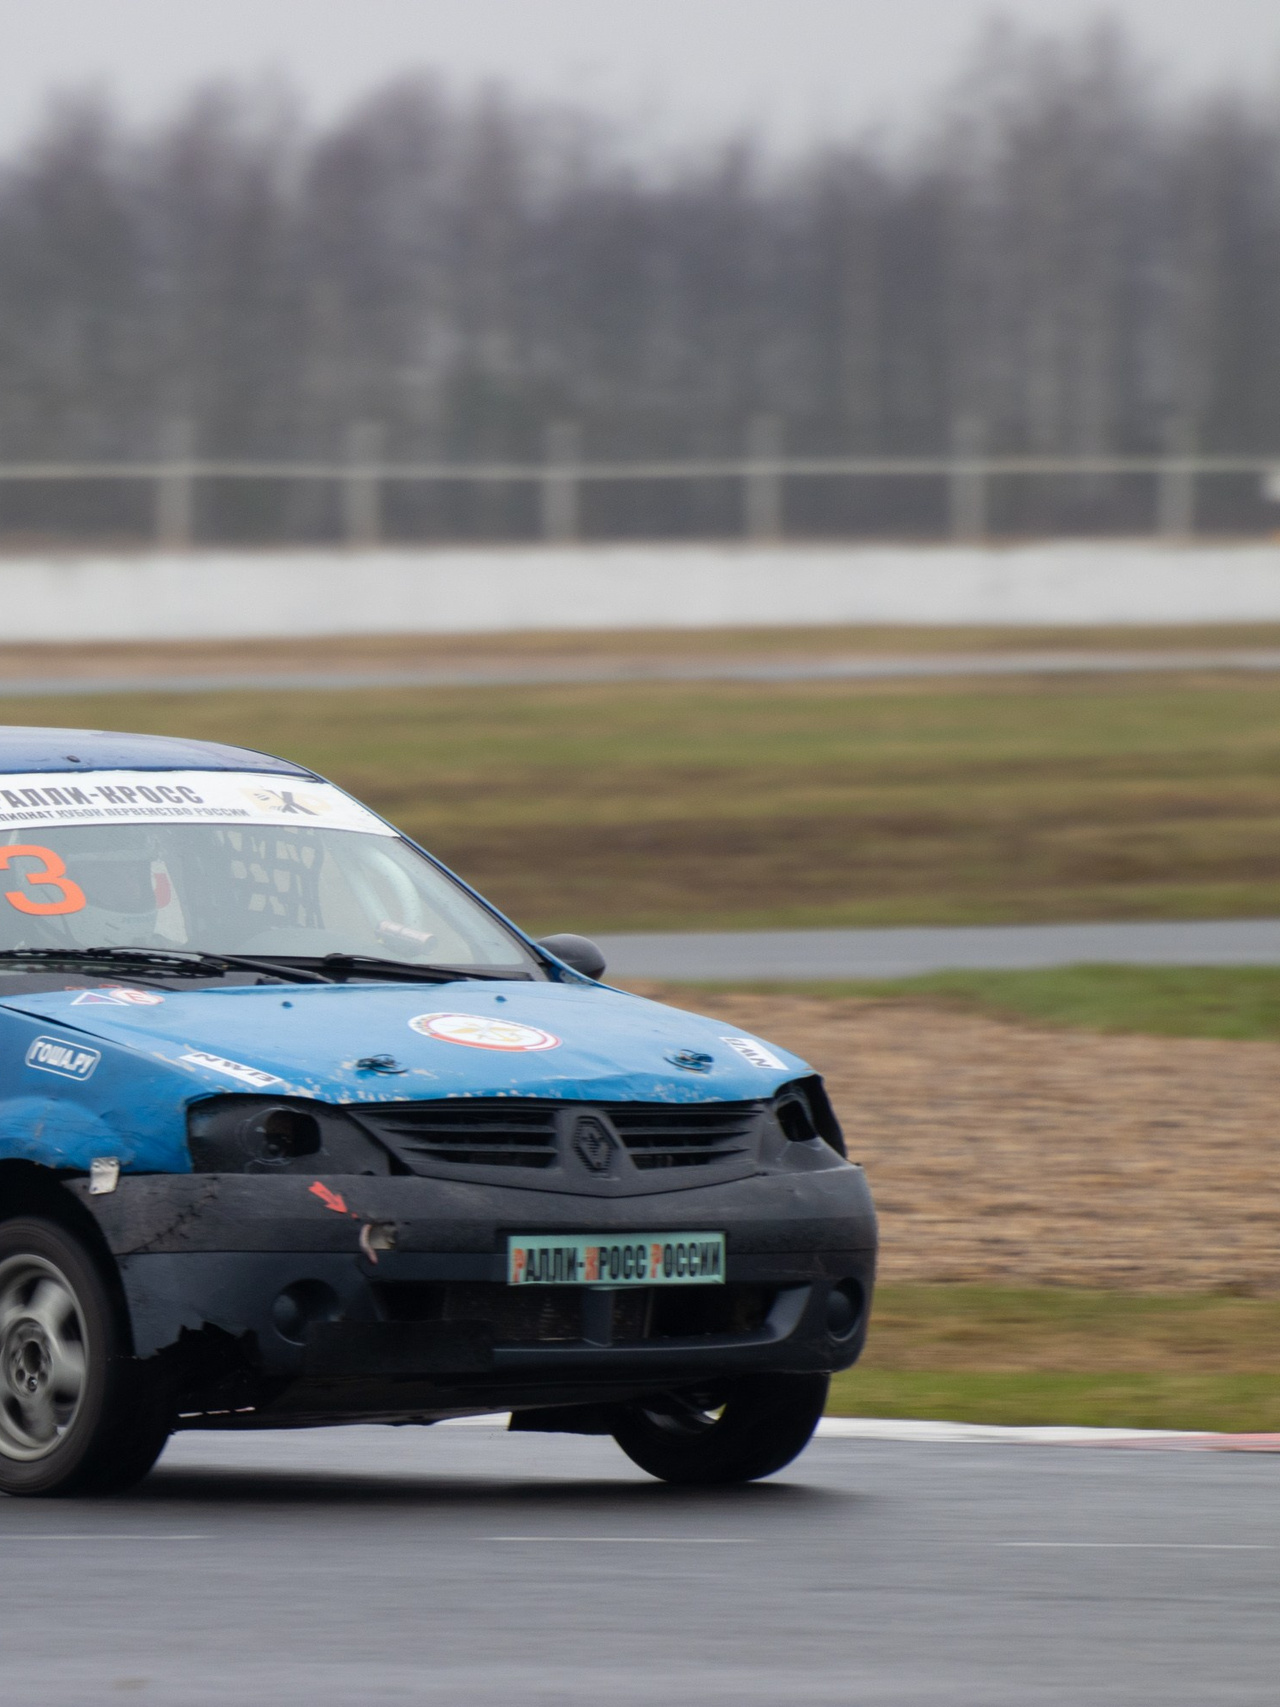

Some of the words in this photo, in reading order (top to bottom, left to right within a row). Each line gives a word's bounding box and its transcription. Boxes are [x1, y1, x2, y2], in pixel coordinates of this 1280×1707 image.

[55, 808, 102, 819] КУБОК
[104, 807, 195, 818] ПЕРВЕНСТВО
[195, 807, 251, 817] РОССИИ
[29, 1041, 96, 1074] ГОША.РУ
[512, 1244, 646, 1283] РАЛЛИ-КРОСС
[650, 1241, 720, 1279] РОССИИ
